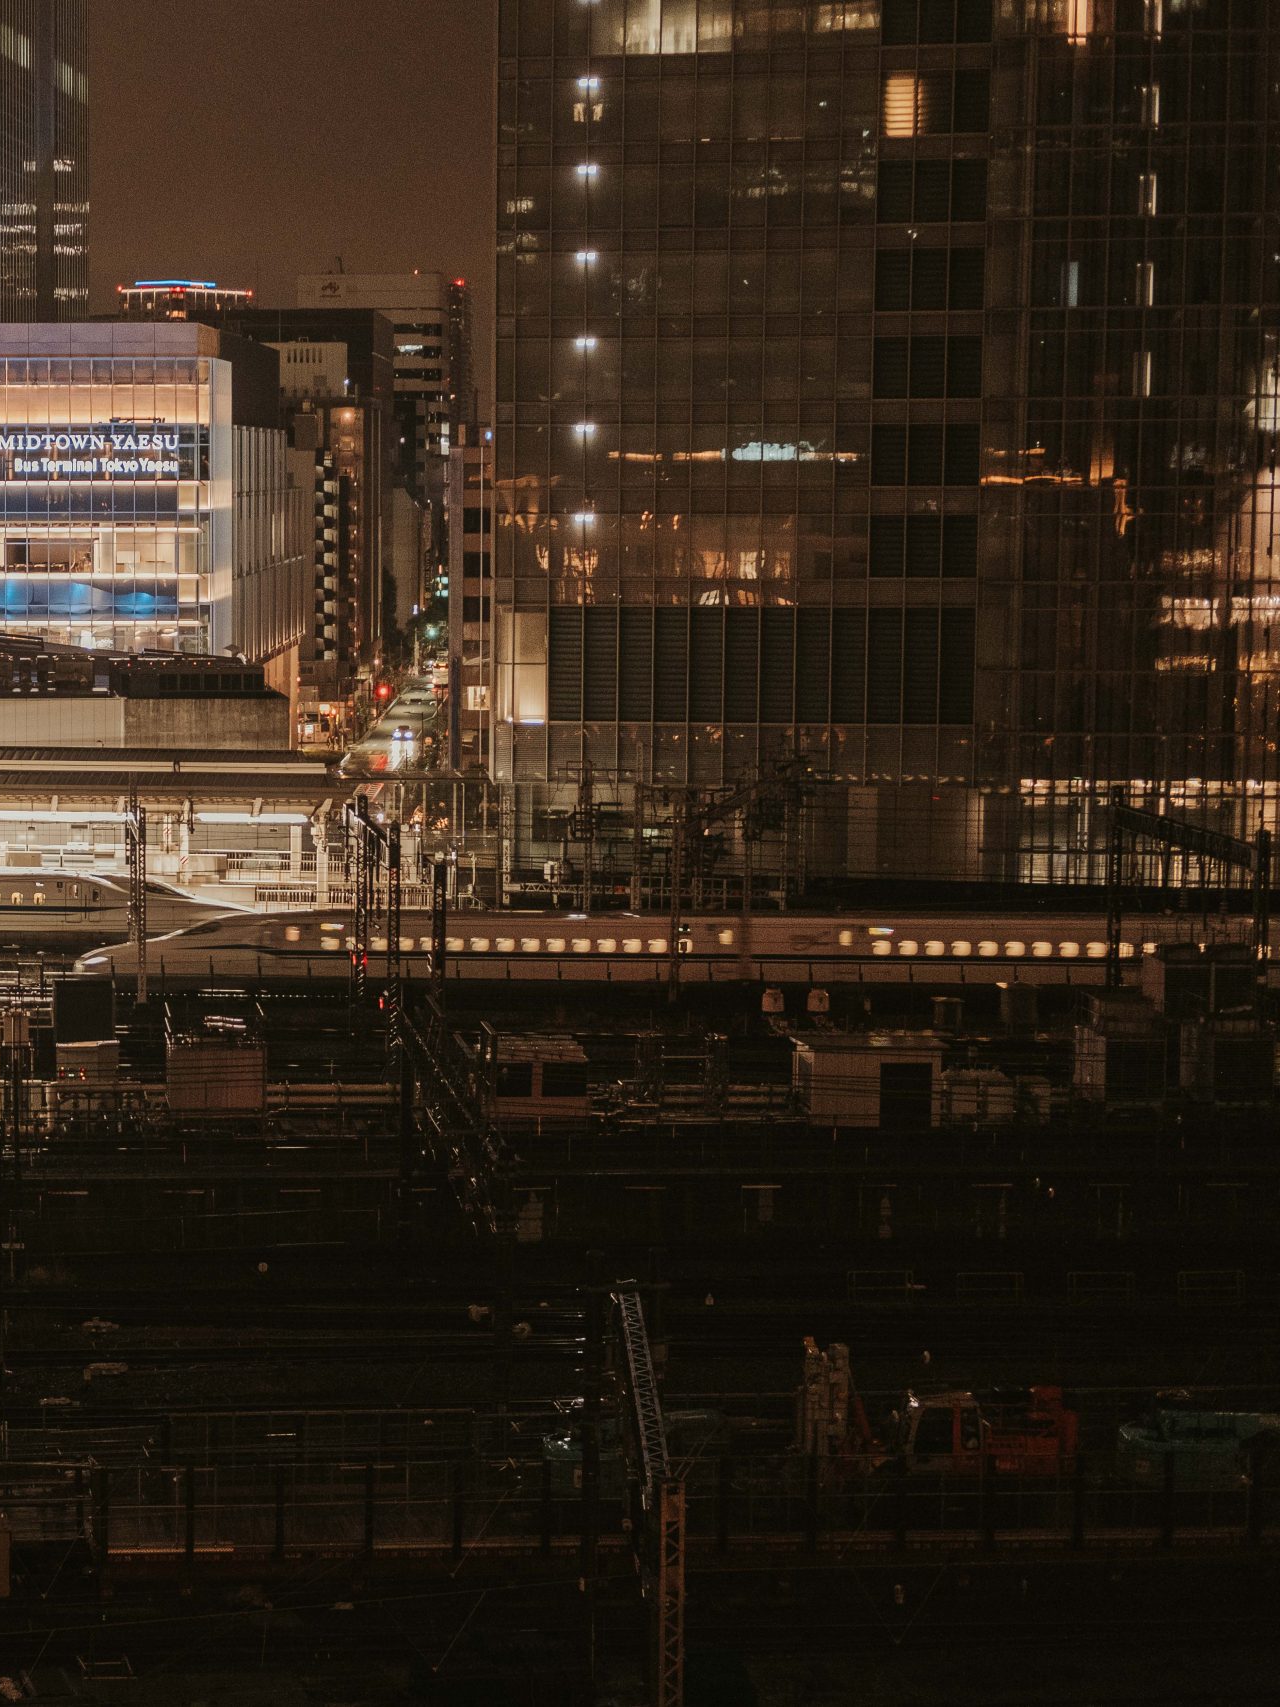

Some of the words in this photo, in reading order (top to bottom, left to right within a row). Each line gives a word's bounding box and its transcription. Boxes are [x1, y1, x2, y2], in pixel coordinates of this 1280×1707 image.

[110, 434, 180, 451] YAESU
[14, 458, 39, 472] Bus
[40, 458, 97, 472] Terminal
[100, 458, 139, 474] Tokyo
[139, 458, 178, 472] Yaesu
